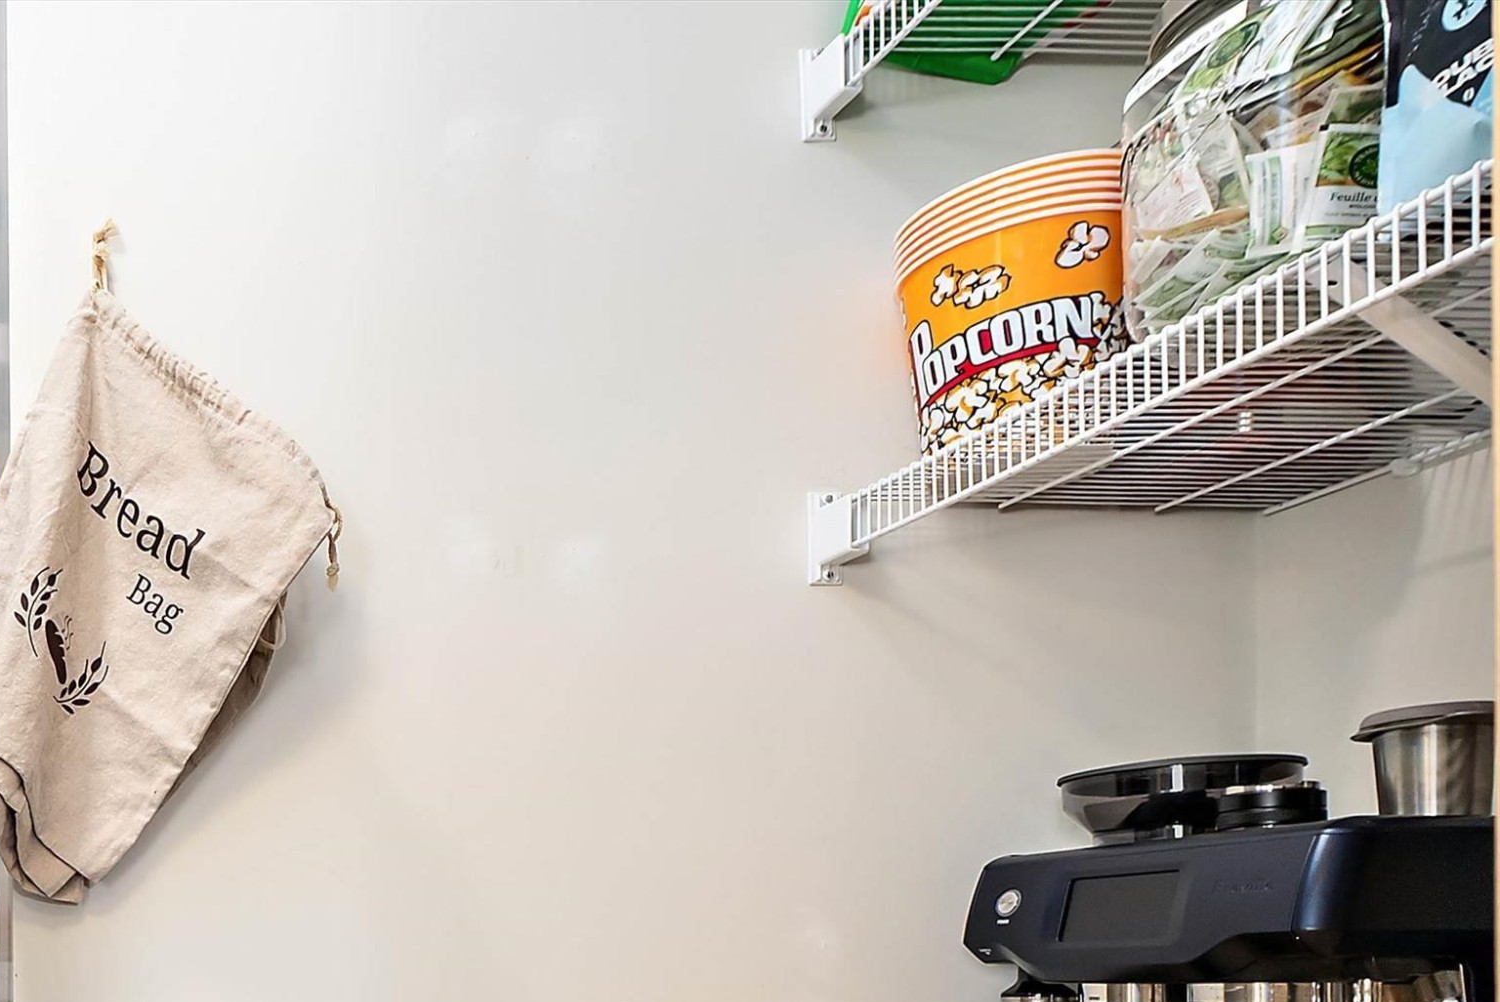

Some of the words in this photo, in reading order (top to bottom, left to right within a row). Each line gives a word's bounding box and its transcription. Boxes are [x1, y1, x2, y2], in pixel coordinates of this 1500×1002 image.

[1330, 192, 1372, 202] Feuille
[909, 295, 1095, 409] POPCORN
[76, 440, 207, 581] Bread
[125, 572, 185, 637] Bag
